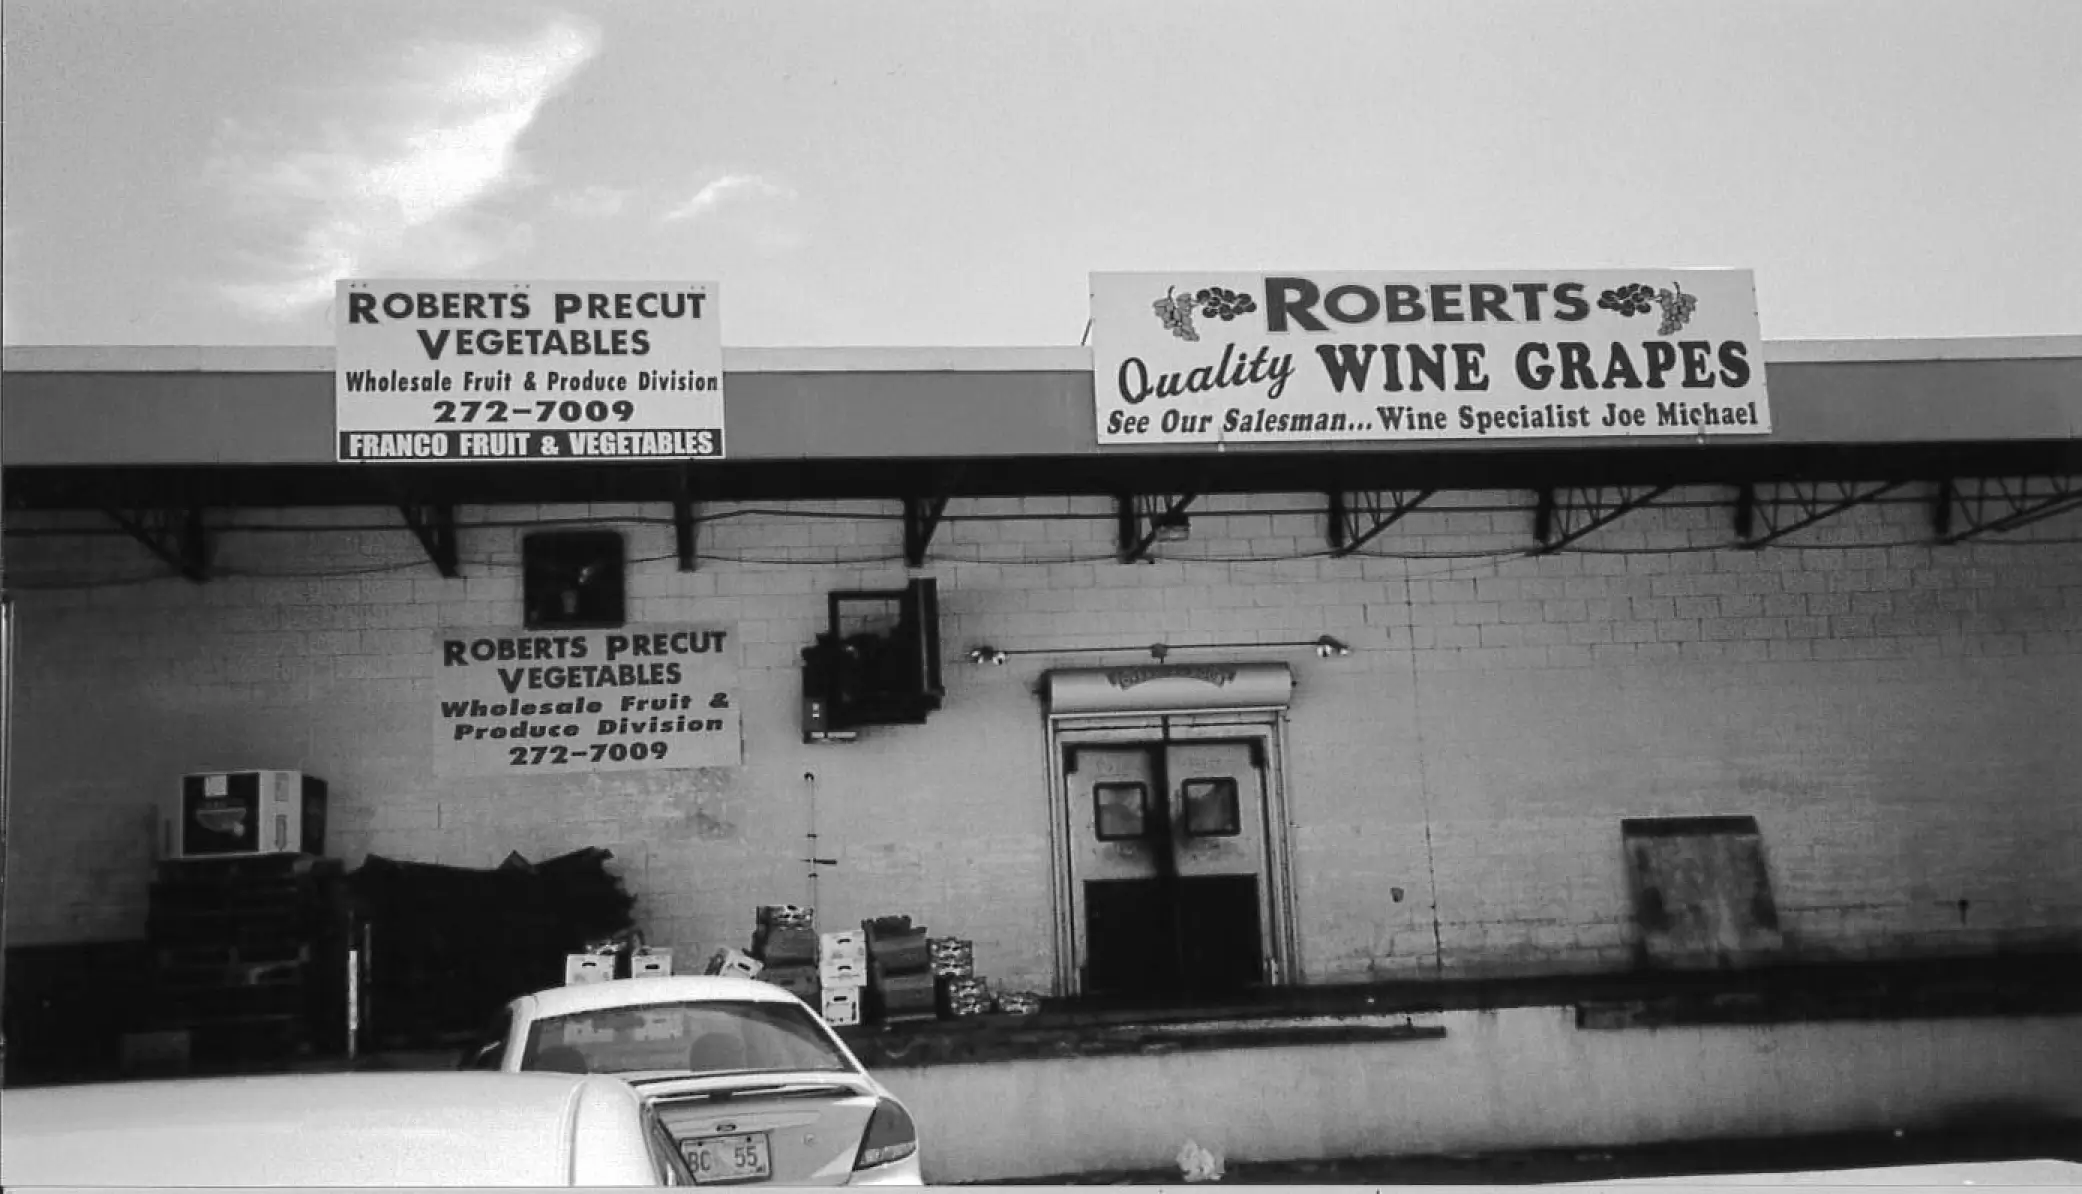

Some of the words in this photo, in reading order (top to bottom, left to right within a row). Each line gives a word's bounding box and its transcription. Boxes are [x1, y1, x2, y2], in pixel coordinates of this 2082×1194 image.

[348, 292, 531, 324] ROBERTS
[555, 292, 706, 323] PRECUT
[1265, 277, 1590, 332] ROBERTS
[416, 329, 651, 360] VEGETABLES
[346, 370, 452, 392] Wholesale
[464, 371, 512, 391] Fruit
[523, 372, 537, 391] &
[547, 370, 627, 392] Produce
[639, 370, 718, 391] Division
[1118, 343, 1296, 404] Quality
[1315, 343, 1490, 392] WINE
[1515, 340, 1751, 390] GRAPES
[433, 400, 635, 423] 272-7009
[1107, 409, 1150, 434] See
[1161, 409, 1212, 433] Our
[1223, 408, 1373, 433] Salesman...
[1377, 406, 1447, 431] Wine
[1458, 404, 1591, 434] Specialist
[1602, 402, 1647, 427] Joe
[1656, 401, 1759, 426] Michael
[350, 433, 448, 458] FRANCO
[460, 432, 531, 457] FRUIT
[540, 434, 560, 456] &
[569, 431, 714, 456] VEGETABLES
[443, 636, 588, 667] ROBERTS
[605, 631, 727, 661] PRECUT
[498, 662, 682, 694] VEGETABLES
[441, 696, 603, 718] Wholesale
[620, 693, 692, 712] Fruit
[709, 692, 730, 709] &
[453, 720, 580, 741] Produce
[597, 715, 724, 736] Division
[509, 741, 668, 766] 272-7009
